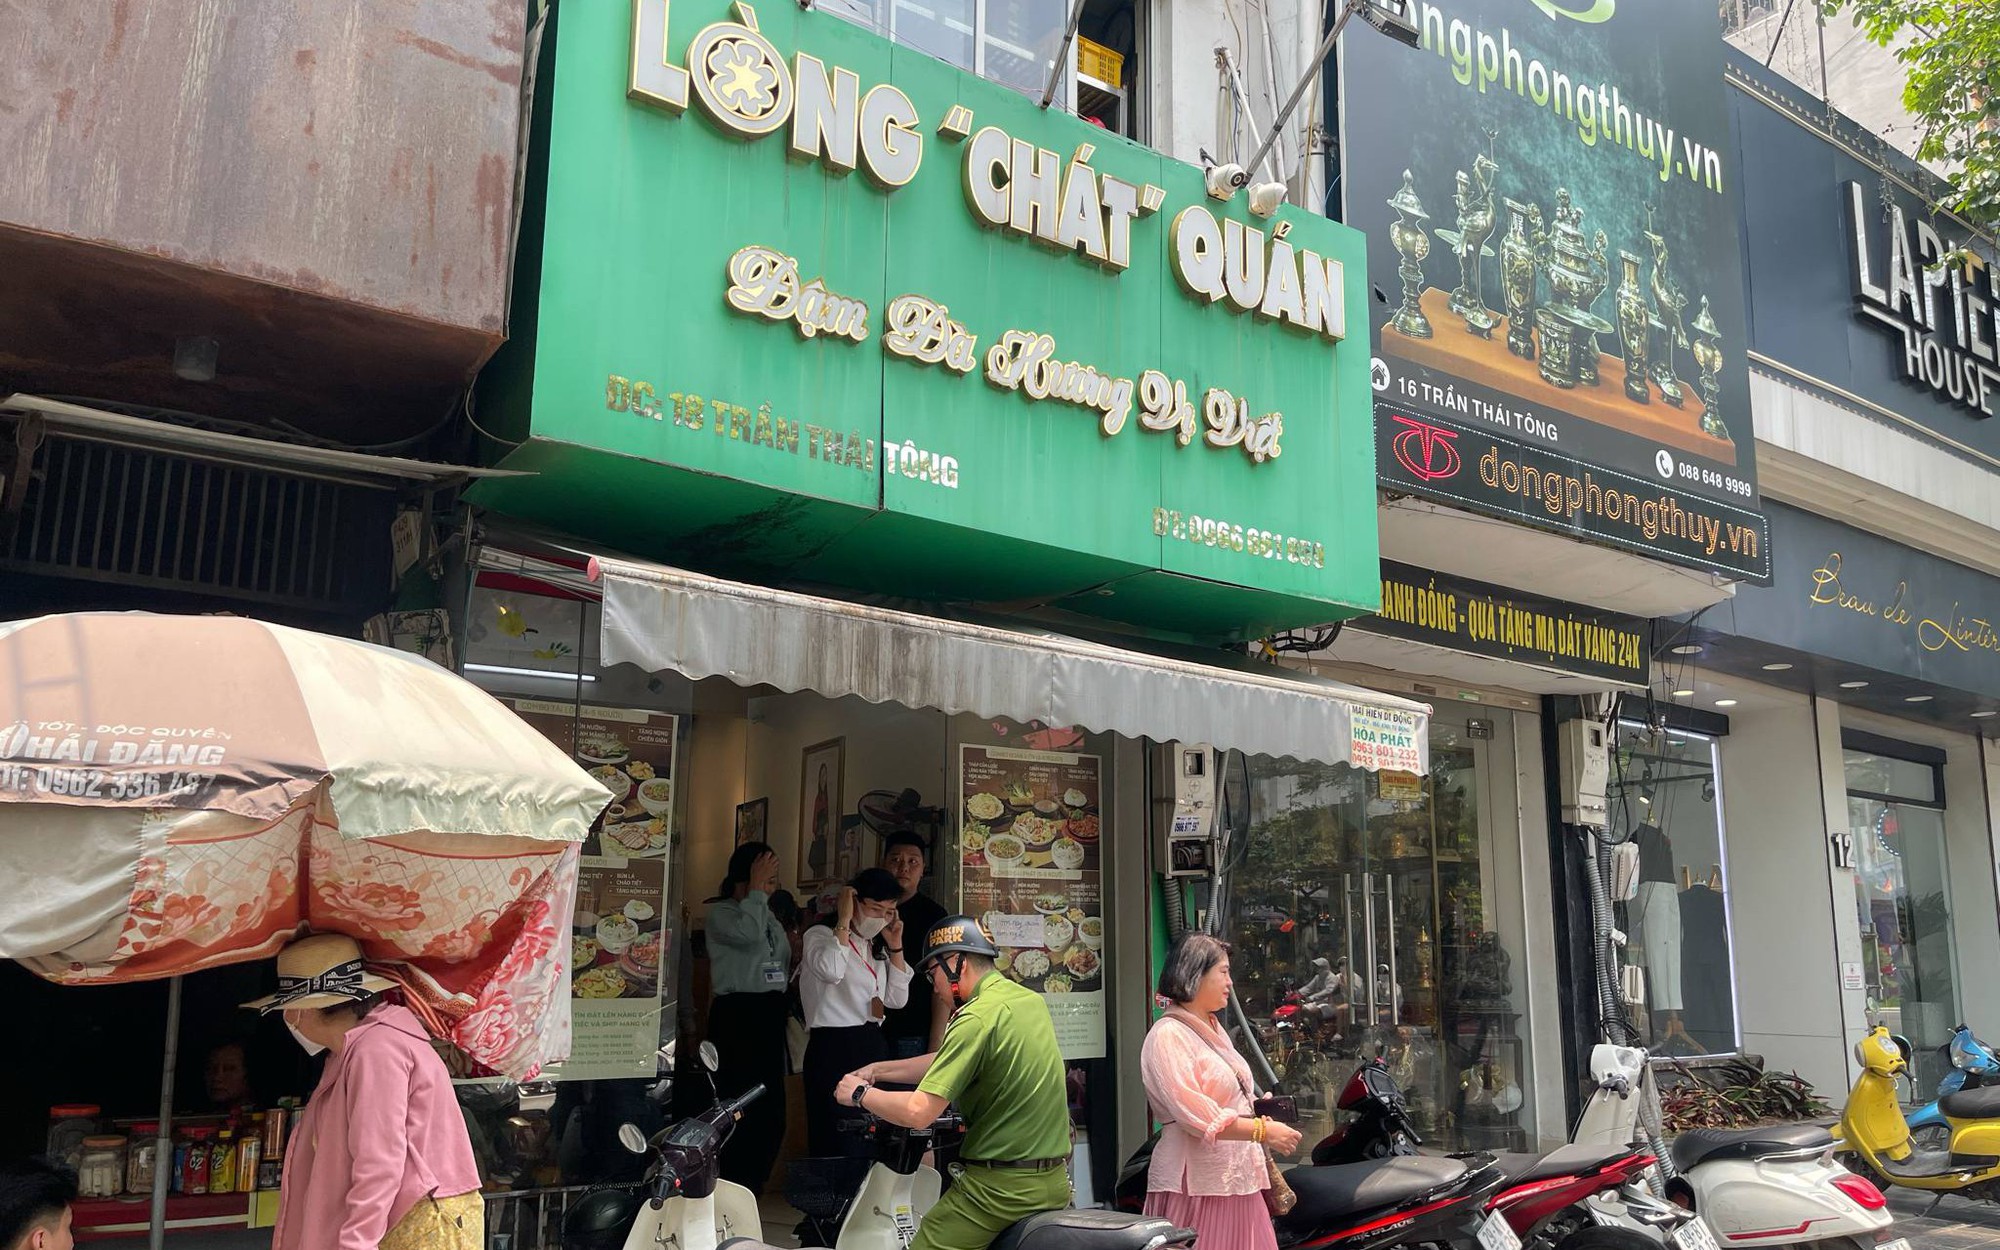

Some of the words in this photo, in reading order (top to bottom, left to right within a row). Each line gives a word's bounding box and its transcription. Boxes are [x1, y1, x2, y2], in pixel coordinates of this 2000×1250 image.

[627, 0, 924, 192] LÒNG
[1169, 205, 1346, 344] QUÁN
[725, 245, 869, 343] Đậm
[883, 294, 977, 376] Đà
[983, 329, 1134, 437] Hương
[1903, 327, 1994, 417] HOUSE
[1398, 376, 1418, 398] 16
[1472, 399, 1511, 427] THÁI
[1514, 412, 1559, 442] TÔNG
[882, 439, 959, 489] TÔNG
[1678, 462, 1700, 481] 088
[1702, 469, 1723, 489] 648
[1725, 476, 1752, 498] 9999
[1479, 445, 1758, 559] dongphongthuy.vn
[1810, 552, 1876, 609] Beau
[1883, 581, 1912, 625] de
[1468, 595, 1496, 642] QUÀ
[1499, 600, 1533, 653] TẶNG
[1535, 614, 1556, 662] MẠ
[1558, 613, 1582, 658] DÁT
[1584, 618, 1616, 665] VÀNG
[24, 732, 99, 763] HẢI
[109, 739, 226, 766] ĐĂNG
[1353, 726, 1376, 743] HÒA
[1380, 733, 1412, 748] PHÁT
[1376, 744, 1395, 758] 801
[1398, 748, 1418, 761] 232
[36, 766, 103, 797] 0962
[110, 771, 160, 799] 336
[1831, 833, 1856, 868] 12
[928, 933, 963, 948] PARK
[929, 925, 965, 939] LINKIN
[189, 1156, 204, 1171] C2
